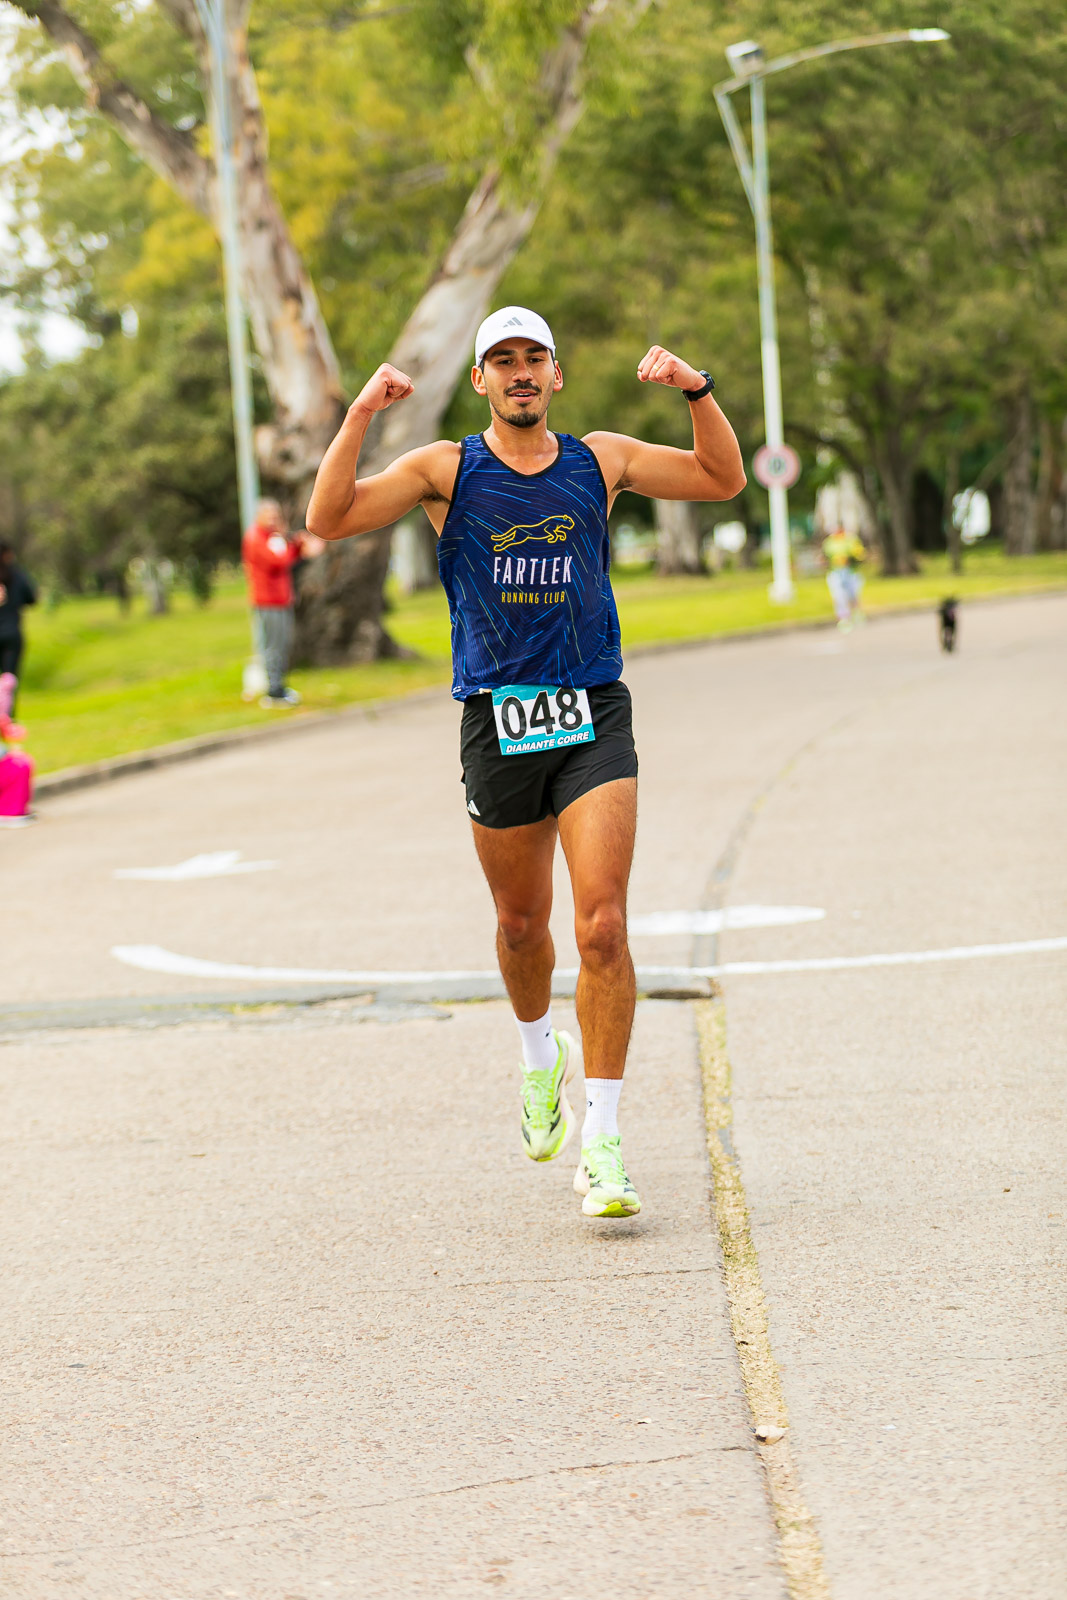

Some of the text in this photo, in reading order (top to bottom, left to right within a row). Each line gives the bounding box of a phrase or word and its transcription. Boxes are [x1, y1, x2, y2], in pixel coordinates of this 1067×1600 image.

[493, 556, 573, 585] FARTLEK
[501, 591, 566, 604] RUNNING CLUB
[501, 687, 583, 741] 048
[506, 731, 590, 753] DIAMANTE CORRE
